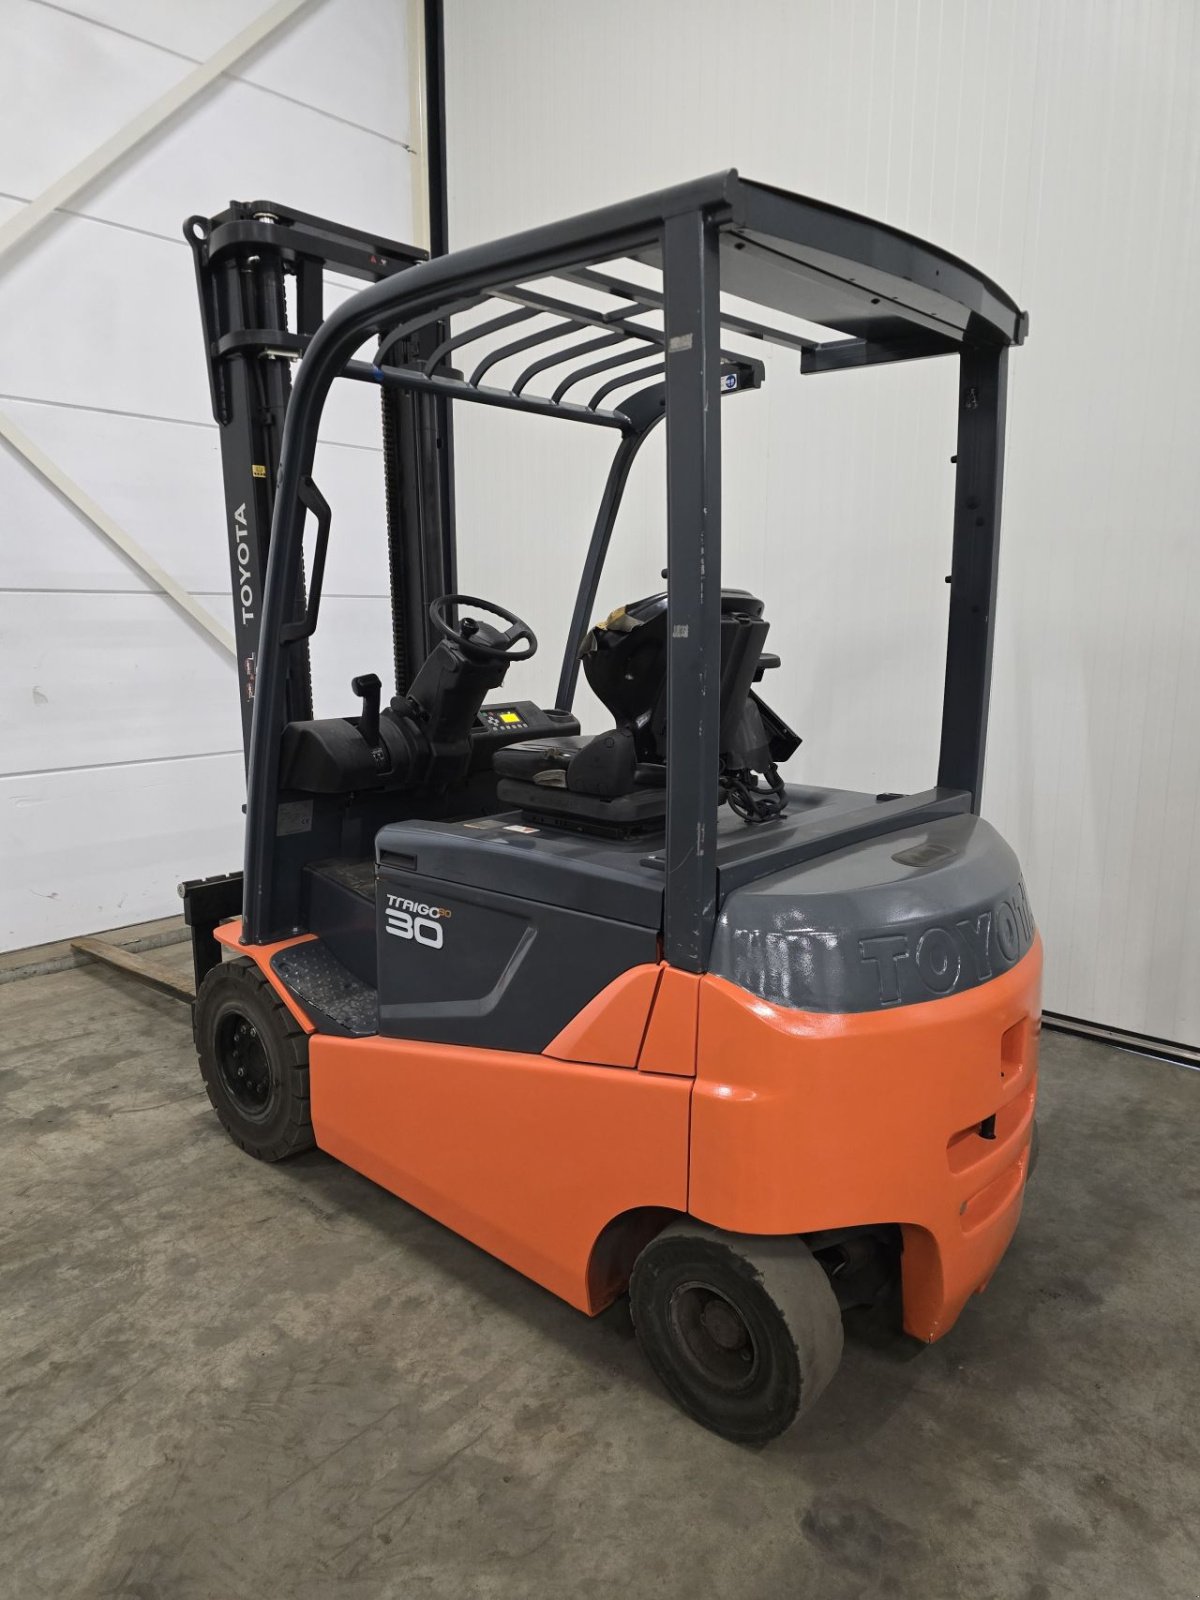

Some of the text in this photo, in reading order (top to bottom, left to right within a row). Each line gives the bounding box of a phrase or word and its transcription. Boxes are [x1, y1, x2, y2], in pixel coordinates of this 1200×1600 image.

[234, 502, 254, 625] TOYOTA
[385, 907, 443, 949] 30
[859, 877, 1036, 1006] TOYOT
